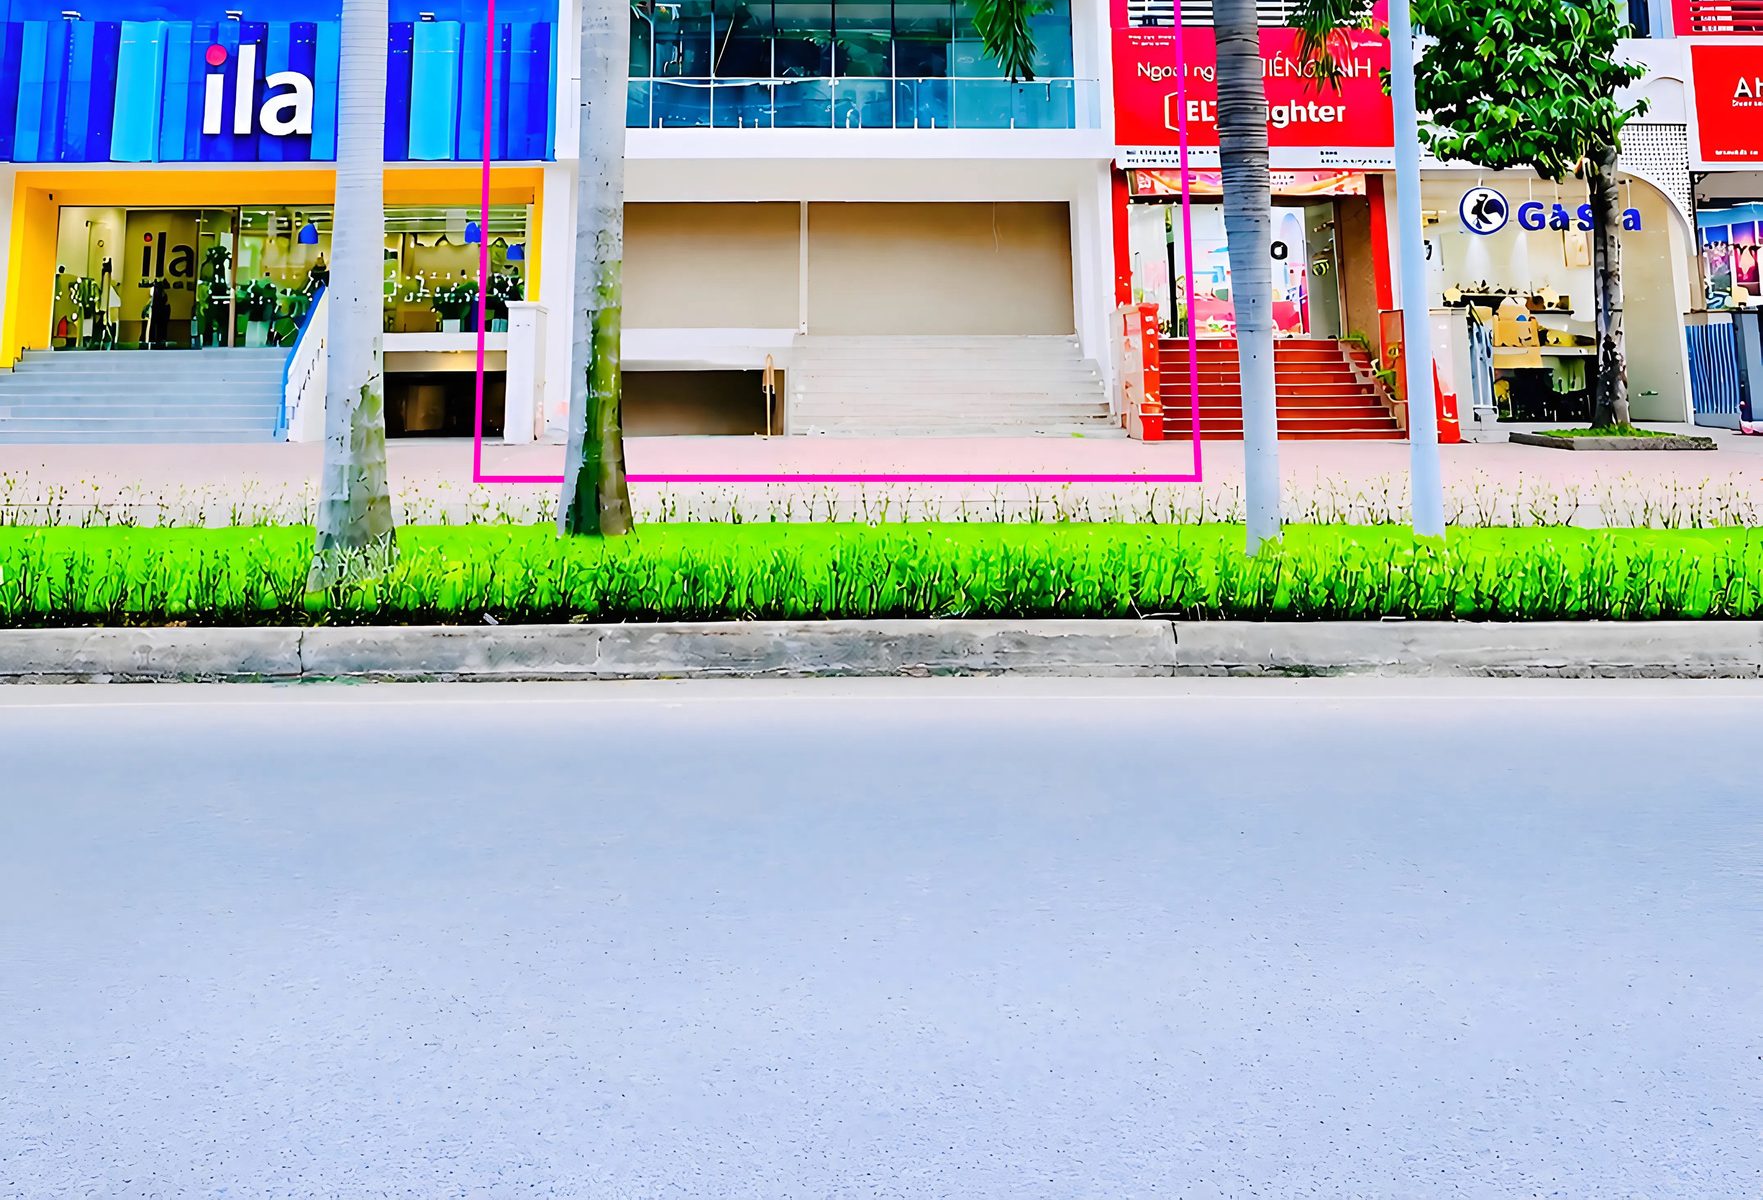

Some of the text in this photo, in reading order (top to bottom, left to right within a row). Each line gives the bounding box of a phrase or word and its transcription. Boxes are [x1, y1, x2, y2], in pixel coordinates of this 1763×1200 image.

[202, 43, 314, 136] ila
[1193, 65, 1217, 82] ng
[1265, 99, 1347, 129] ighter
[142, 232, 194, 278] ila
